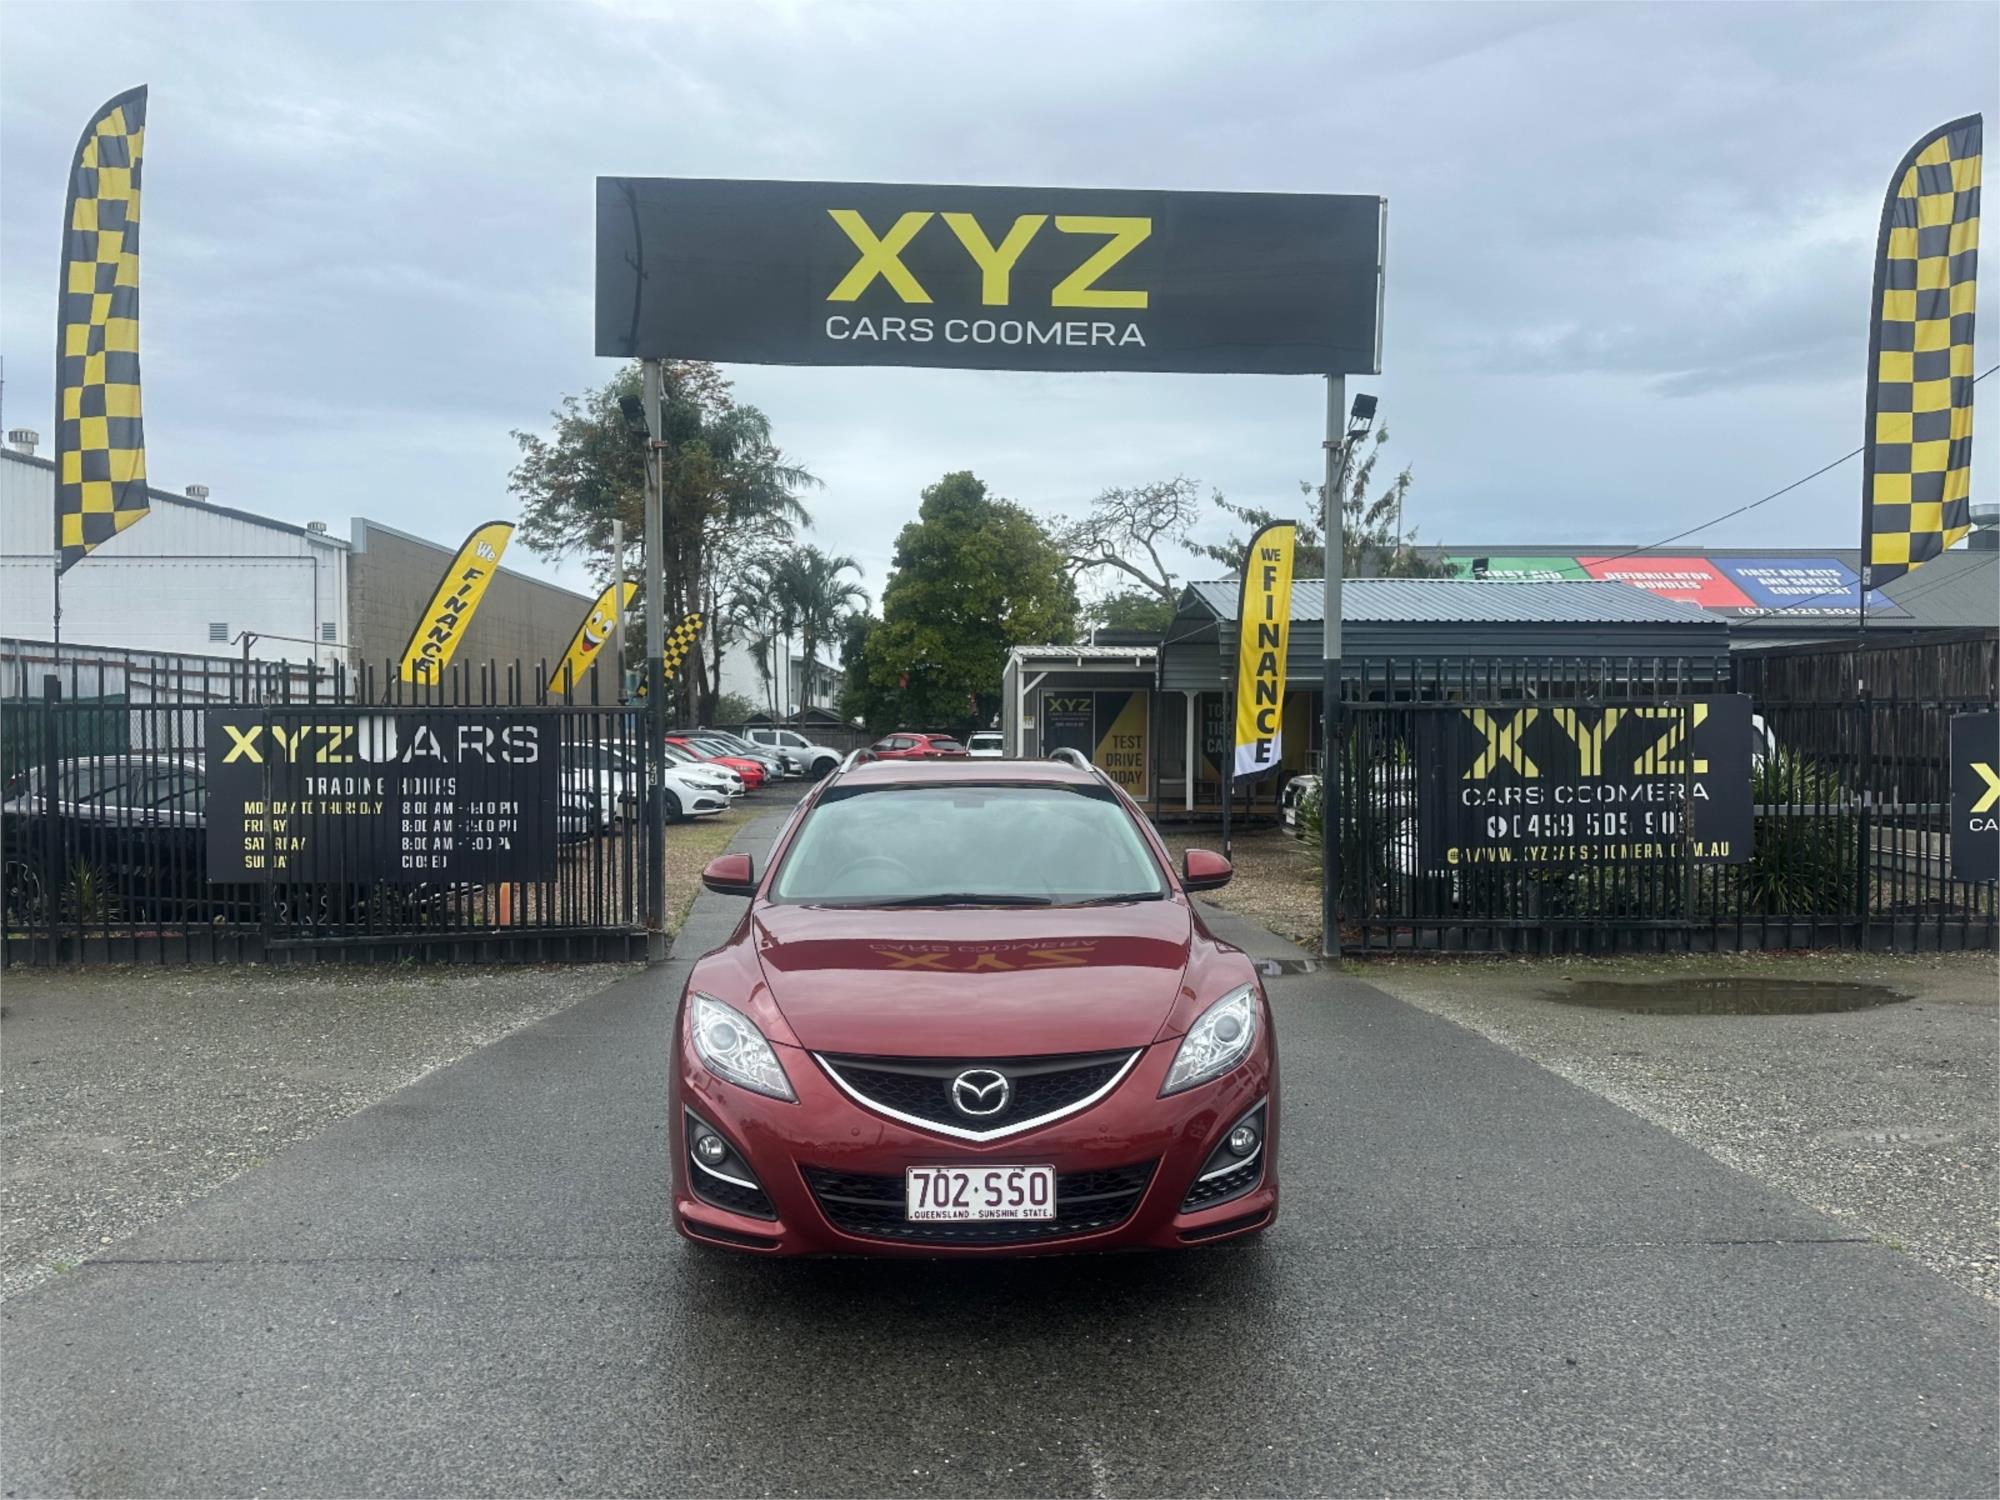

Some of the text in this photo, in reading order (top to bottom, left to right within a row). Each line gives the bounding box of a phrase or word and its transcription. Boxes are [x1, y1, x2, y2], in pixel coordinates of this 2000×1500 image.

[825, 208, 1152, 308] XYZ
[825, 315, 1146, 347] CARS COOMERA
[476, 542, 496, 562] We
[1261, 548, 1281, 562] WE
[1254, 566, 1280, 763] FINANCE
[1049, 699, 1092, 712] XYZ
[1112, 735, 1143, 749] TEST
[1462, 703, 1708, 779] XYZ
[1106, 752, 1142, 767] DRIVE
[1462, 786, 1544, 806] CARS
[244, 802, 296, 815] MODAY
[434, 801, 454, 815] AM
[244, 819, 287, 833] FRIAY
[433, 819, 453, 833] AM
[433, 837, 454, 851] AM
[914, 1210, 970, 1219] QUEENSLAND
[978, 1210, 1018, 1218] SUNSHINE
[1023, 1209, 1048, 1217] STATE
